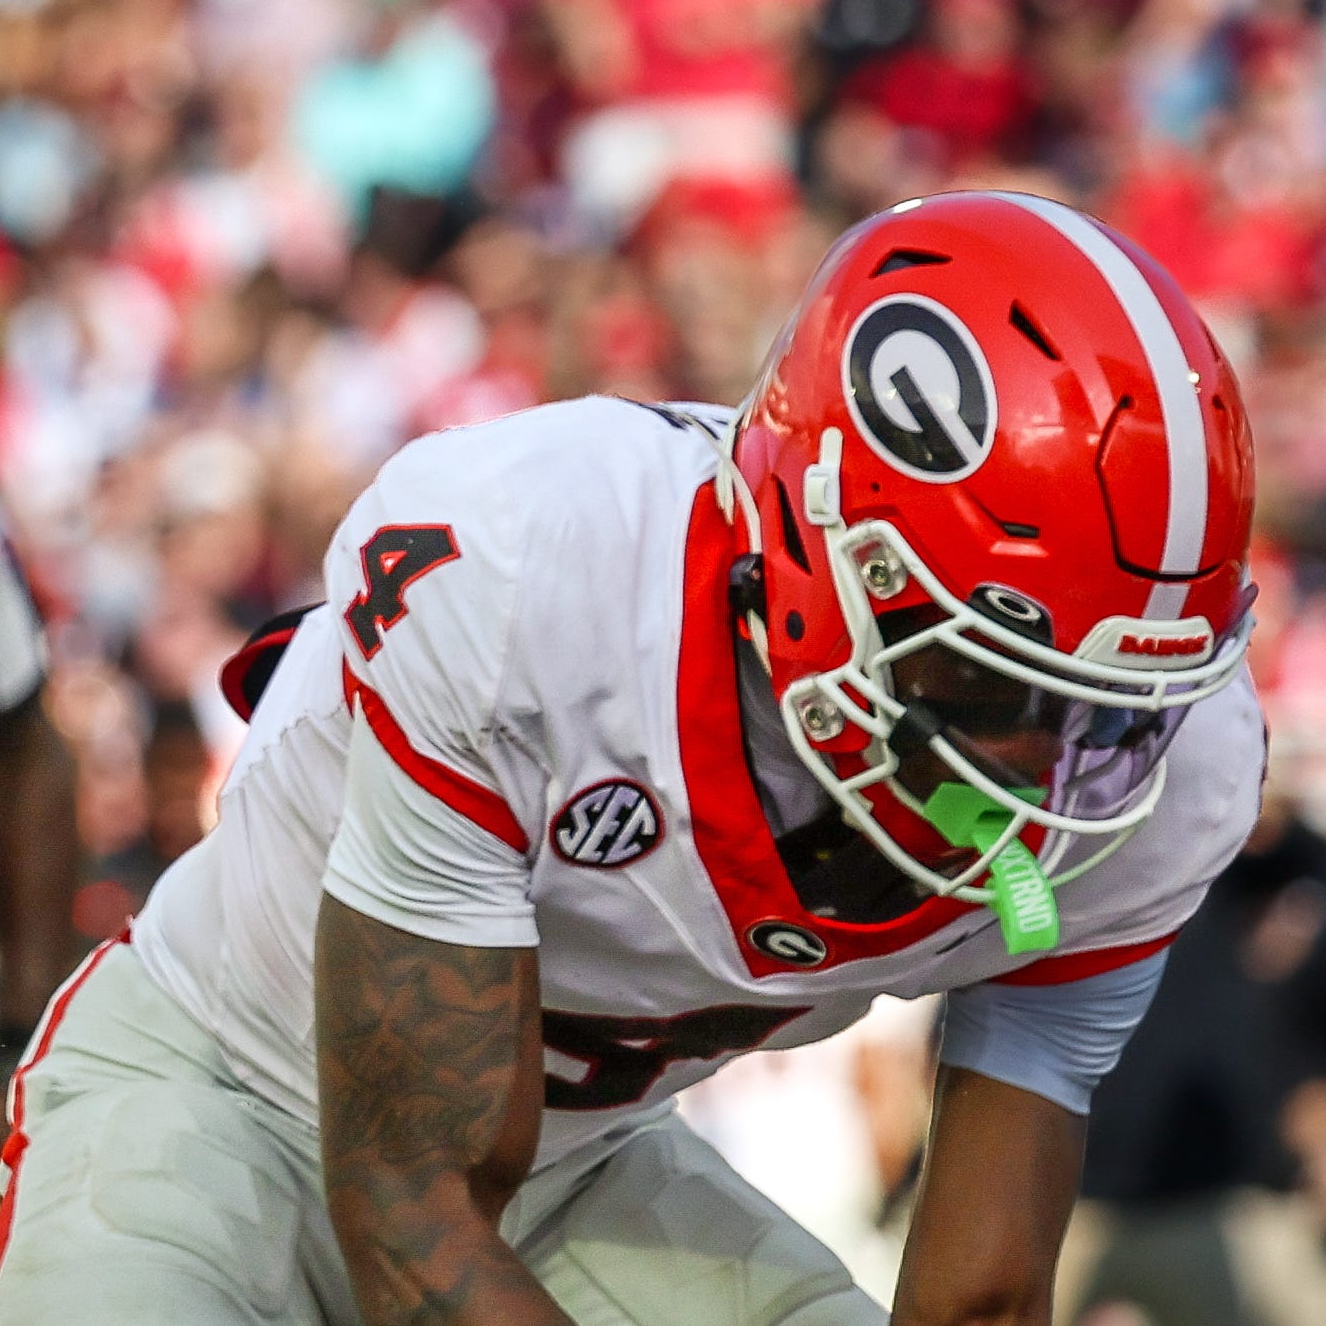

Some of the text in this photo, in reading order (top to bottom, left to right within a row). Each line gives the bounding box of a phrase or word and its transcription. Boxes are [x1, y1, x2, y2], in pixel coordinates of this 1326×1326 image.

[849, 302, 988, 473] G
[344, 524, 462, 662] 4
[555, 784, 657, 865] SEC
[751, 922, 827, 967] G
